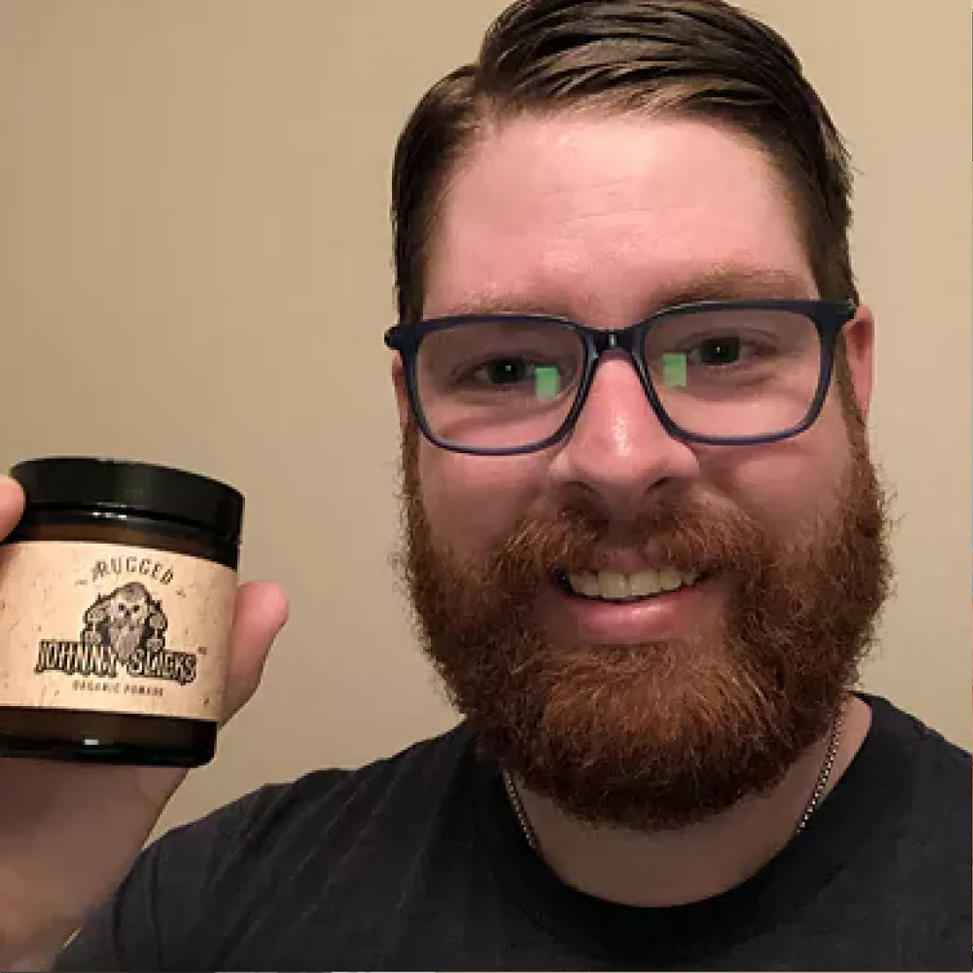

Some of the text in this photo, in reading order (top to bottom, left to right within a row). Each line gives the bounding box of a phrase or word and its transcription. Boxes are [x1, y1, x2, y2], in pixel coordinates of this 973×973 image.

[92, 556, 174, 585] RUGGED
[34, 639, 197, 685] JOHNNY SLICKS
